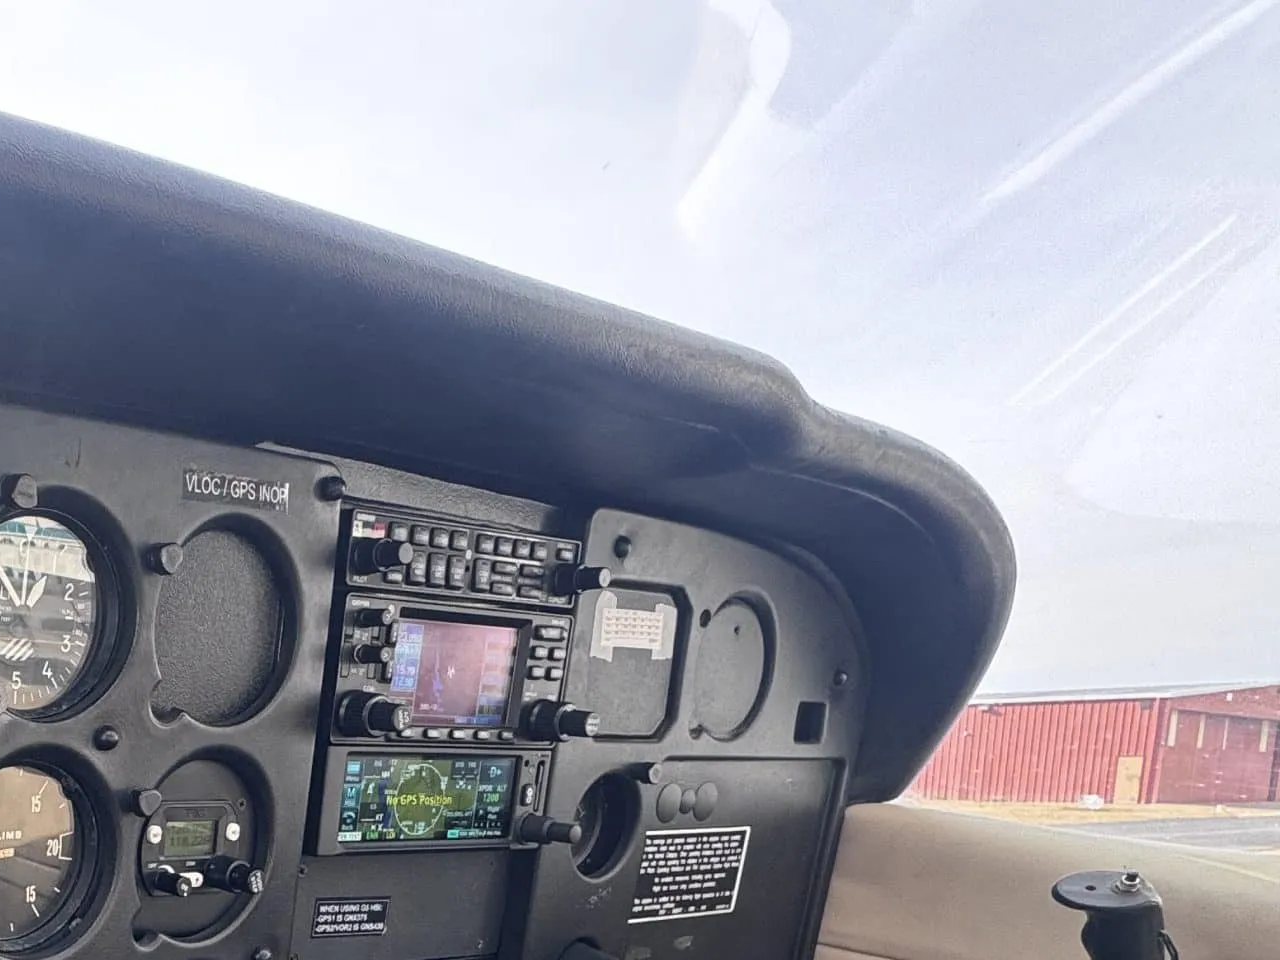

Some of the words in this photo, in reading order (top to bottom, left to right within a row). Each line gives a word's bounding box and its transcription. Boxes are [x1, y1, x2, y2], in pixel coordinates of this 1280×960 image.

[186, 475, 221, 496] VLOC
[223, 481, 229, 497] /
[231, 481, 256, 500] GPS
[259, 485, 288, 504] INOP
[64, 583, 74, 601] 2
[61, 635, 71, 652] 3
[42, 661, 53, 679] 4
[11, 672, 21, 689] 5
[31, 796, 41, 813] 15
[387, 795, 398, 805] No
[400, 795, 417, 805] GPS
[419, 795, 452, 807] Position
[46, 839, 59, 857] 20
[26, 886, 36, 903] 15
